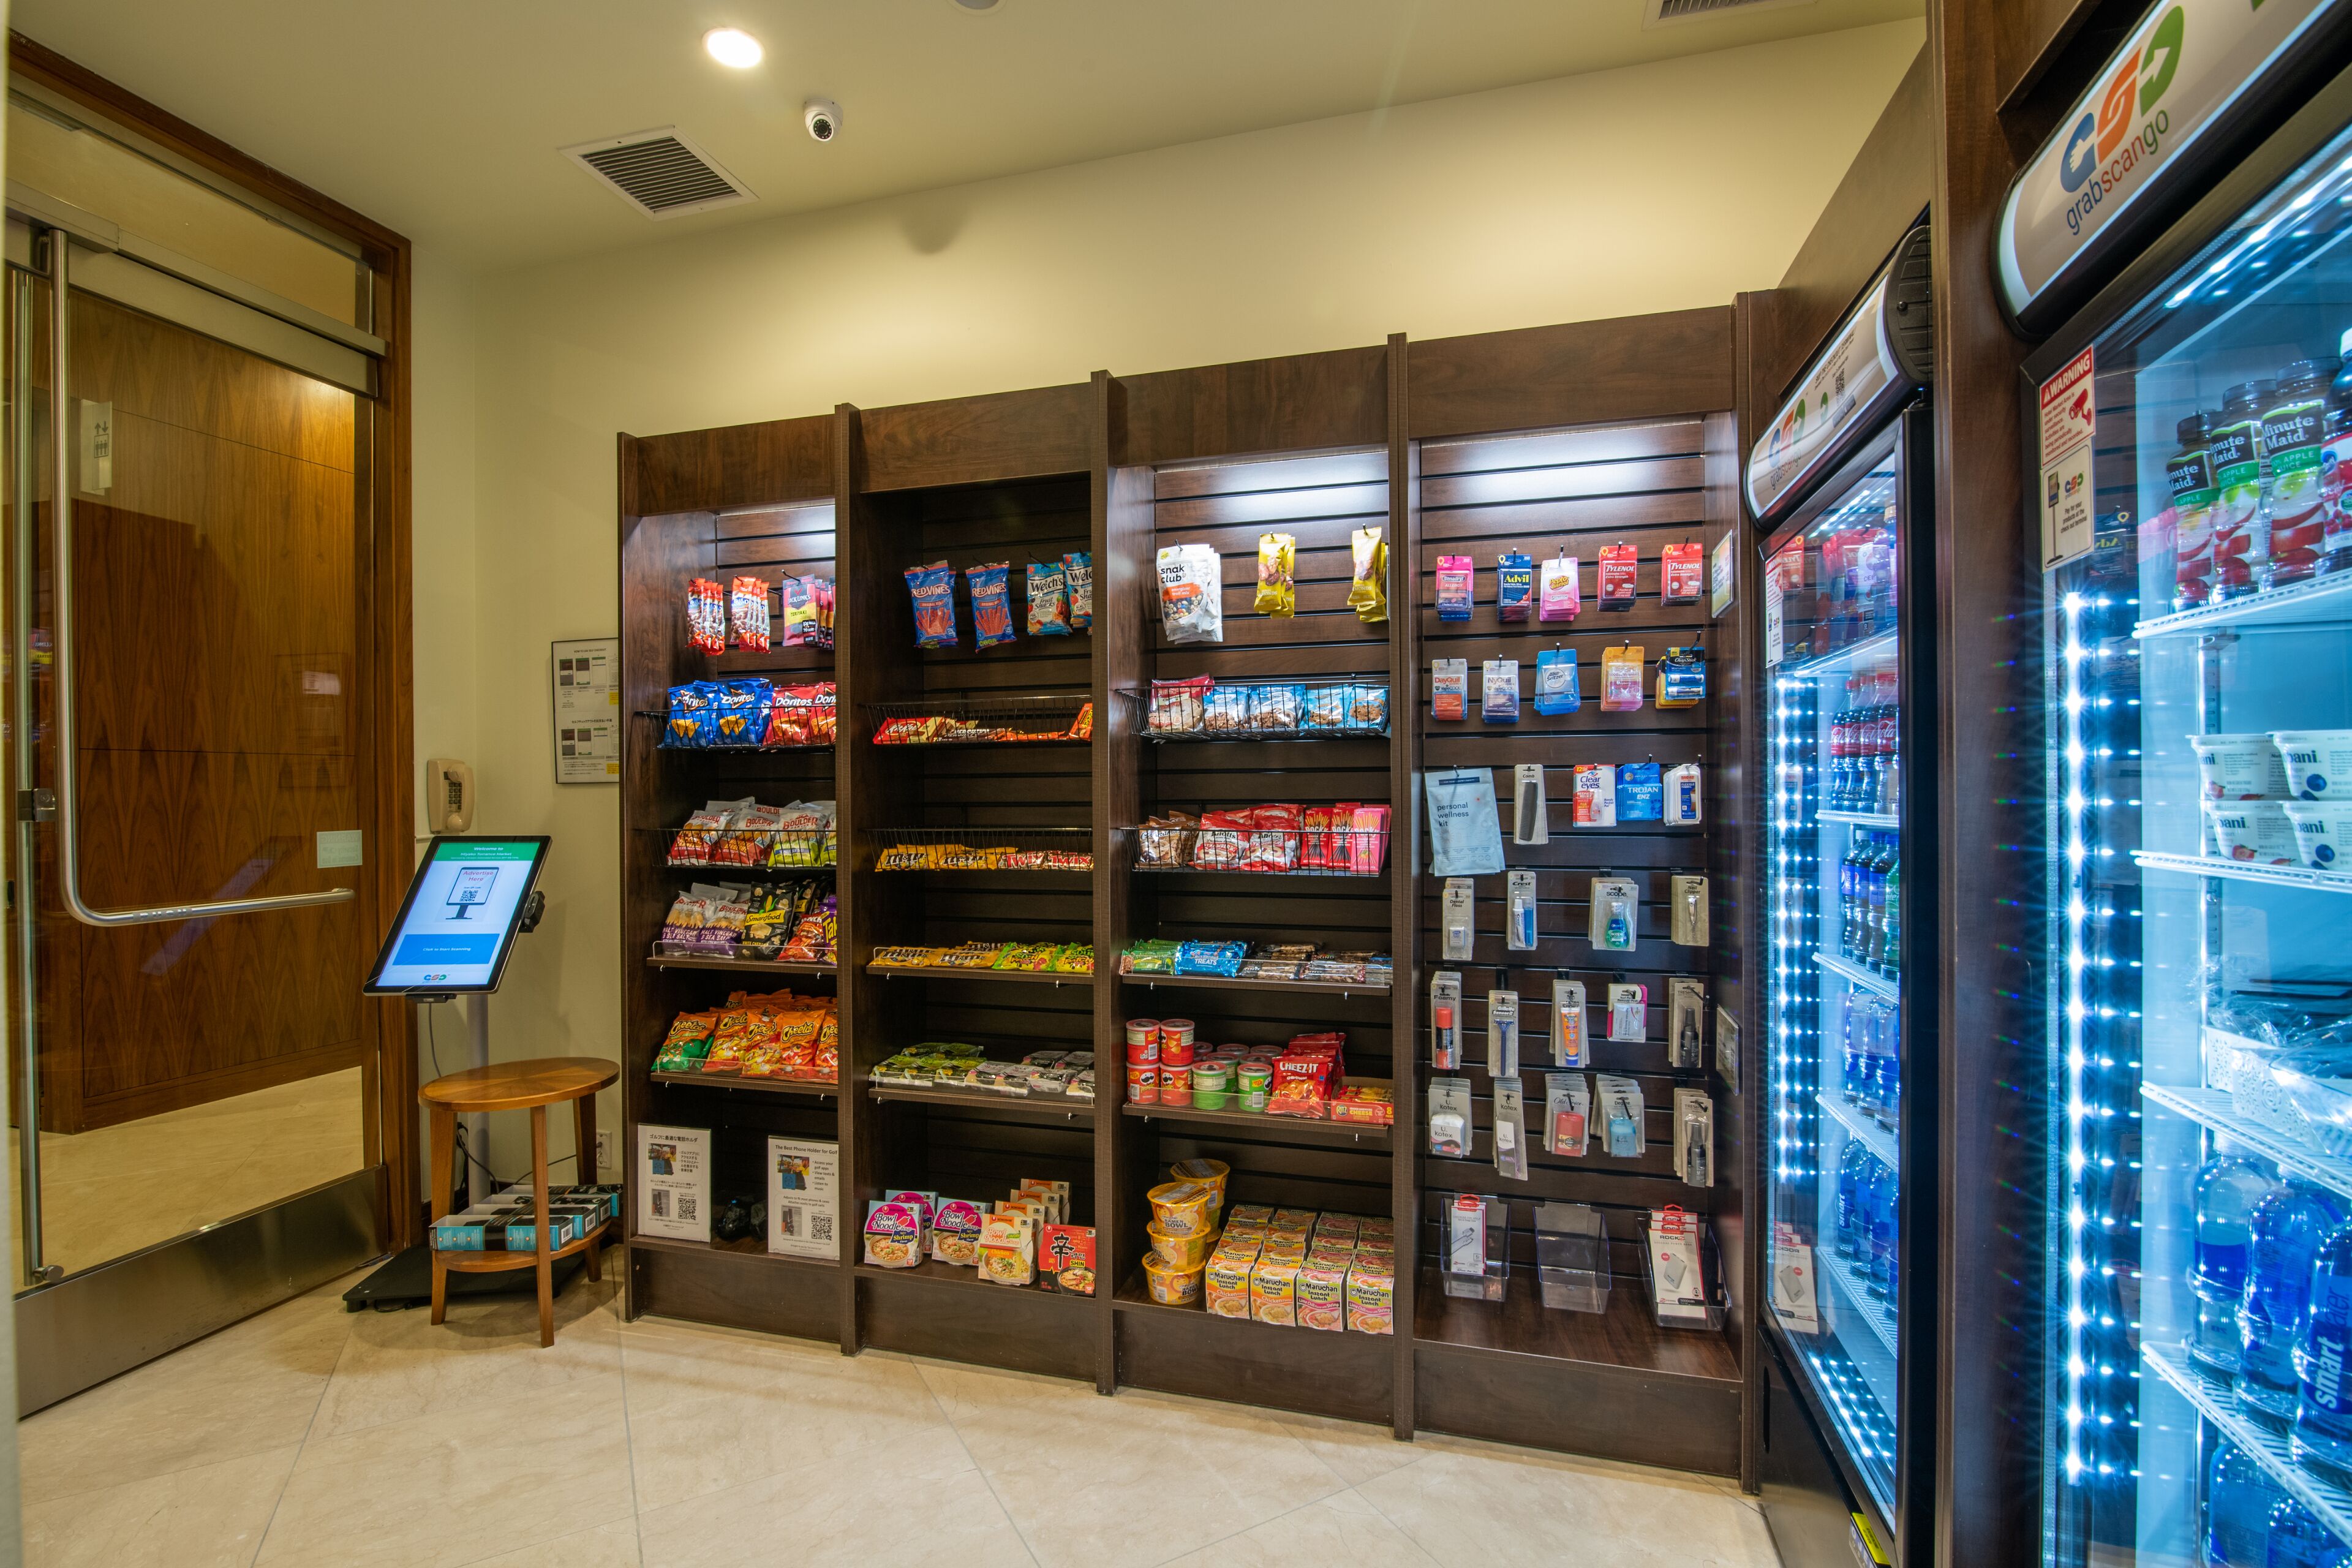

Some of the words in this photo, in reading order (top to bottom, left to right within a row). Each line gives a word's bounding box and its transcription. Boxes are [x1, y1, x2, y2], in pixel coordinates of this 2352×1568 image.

[2065, 109, 2170, 236] grabscango
[2050, 354, 2090, 398] WARNING
[2052, 401, 2063, 412] Market
[2045, 417, 2053, 426] under
[2054, 407, 2067, 420] security
[2045, 429, 2059, 441] Activities
[2054, 428, 2071, 444] periodically
[2267, 431, 2307, 450] Maid
[2045, 444, 2060, 458] monitored
[2283, 451, 2314, 467] APPLE
[1770, 447, 1803, 491] grabscango
[2222, 468, 2246, 478] APPLE
[2063, 513, 2075, 524] products
[2075, 516, 2087, 526] terminal
[1160, 564, 1185, 575] snak
[1161, 574, 1182, 584] club
[1030, 577, 1063, 594] Welch's
[1035, 601, 1055, 610] Snacks
[722, 693, 755, 704] Doritos
[775, 697, 813, 707] Doritos
[1437, 802, 1468, 812] personal
[745, 816, 775, 828] BOULDER
[783, 817, 818, 830] BOULDER
[747, 913, 780, 922] Smartfood
[669, 1019, 707, 1036] Cheetos
[782, 1022, 814, 1042] Cheetos
[875, 1213, 897, 1222] Bowl
[943, 1210, 965, 1219] Bowl
[872, 1221, 901, 1231] Noodle
[940, 1218, 968, 1228] Noodle
[987, 1227, 1006, 1236] Bowl
[984, 1235, 1010, 1243] Noodle
[1050, 1233, 1074, 1268] 辛
[1215, 1272, 1245, 1281] Maruchan
[1260, 1278, 1291, 1287] Maruchan
[1305, 1283, 1338, 1292] Maruchan
[1356, 1288, 1389, 1297] Maruchan
[2314, 1335, 2344, 1409] smart
